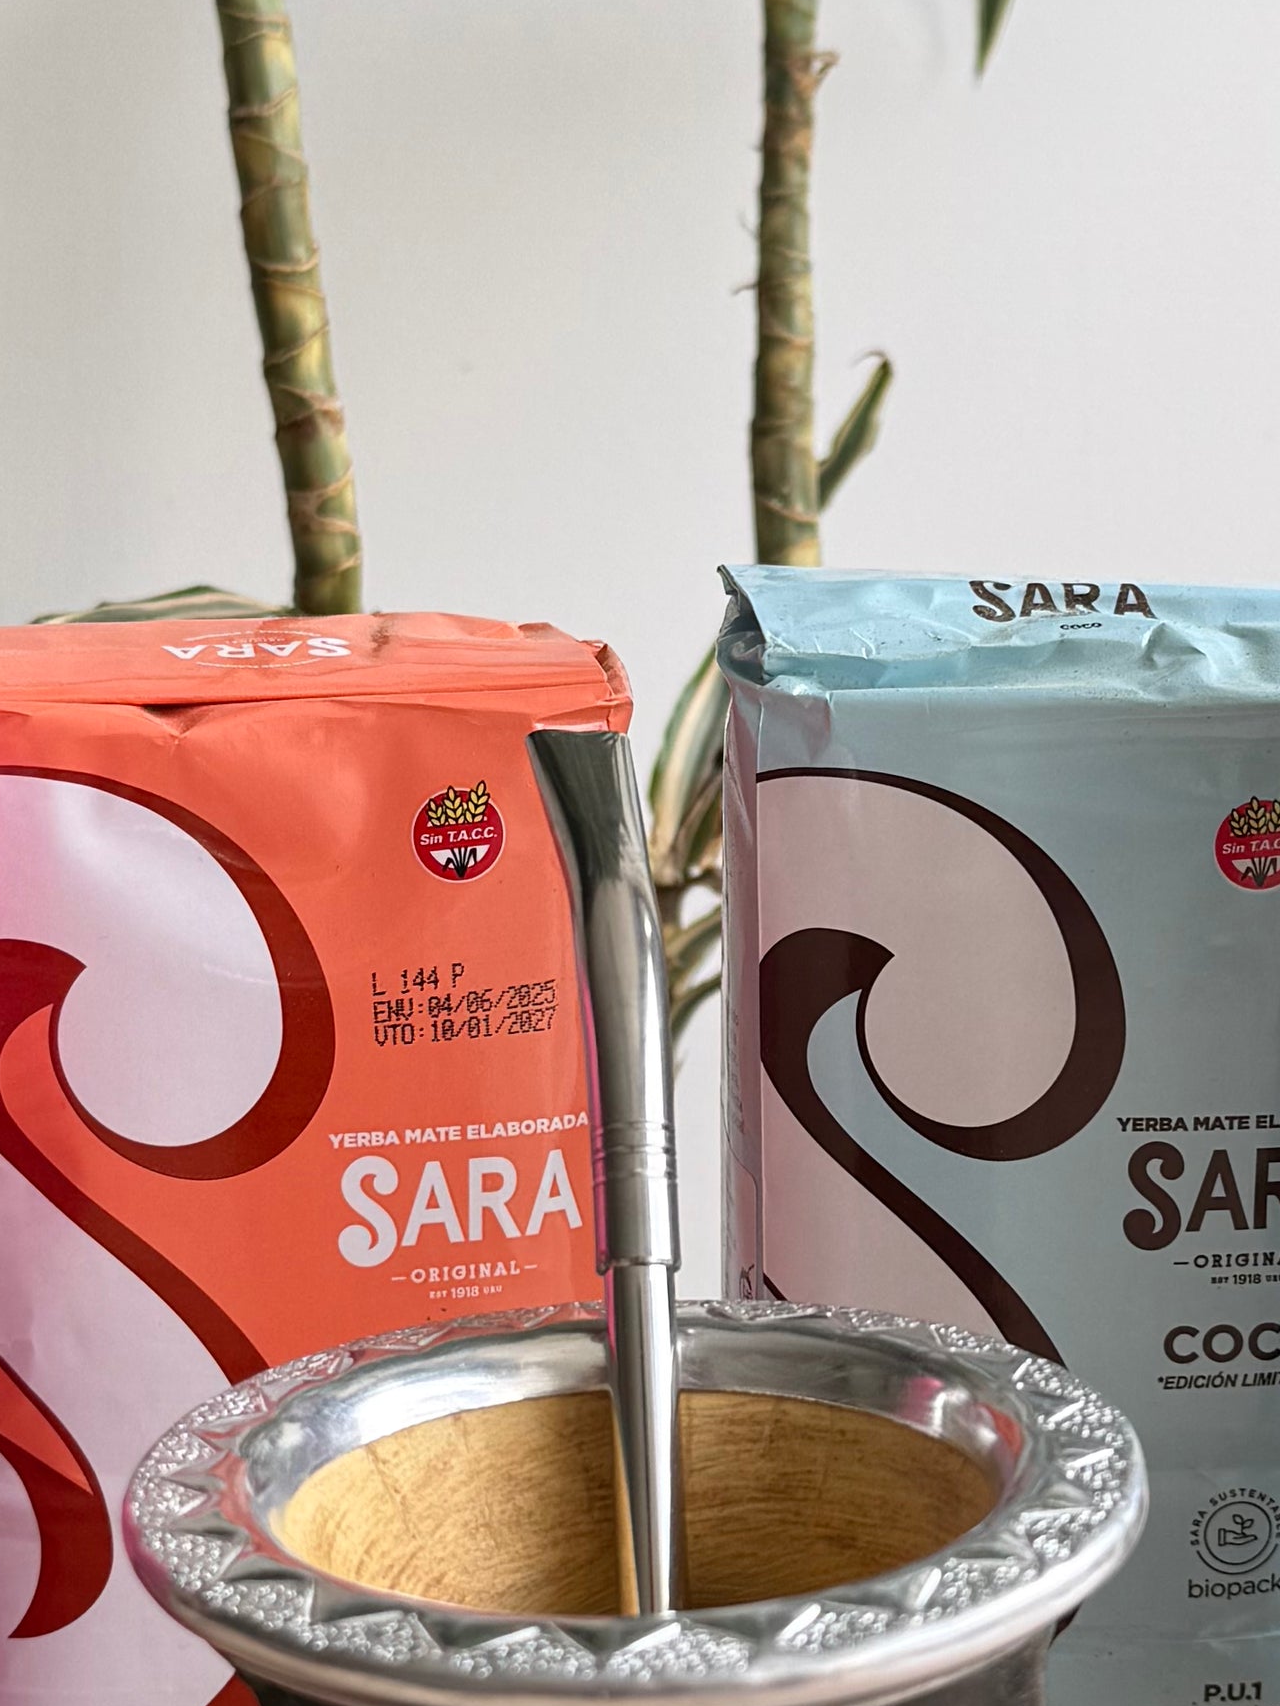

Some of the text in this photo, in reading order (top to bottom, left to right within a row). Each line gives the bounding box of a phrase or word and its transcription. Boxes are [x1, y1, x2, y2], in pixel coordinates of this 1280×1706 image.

[969, 580, 1158, 622] SARA
[161, 637, 352, 660] SARA
[420, 826, 498, 846] Sin T.A.C.C.
[1222, 843, 1245, 854] Sin
[371, 963, 464, 996] L 144 P
[328, 1111, 589, 1149] YERBA MATE ELABORADA
[1117, 1117, 1189, 1132] YERBA
[1193, 1115, 1251, 1131] MATE
[338, 1148, 583, 1268] SARA
[410, 1260, 521, 1284] ORIGINAL
[1233, 1274, 1261, 1285] 1918
[450, 1285, 479, 1299] 1918
[1190, 1510, 1208, 1546] SARA
[1204, 1681, 1262, 1702] P.U.1
